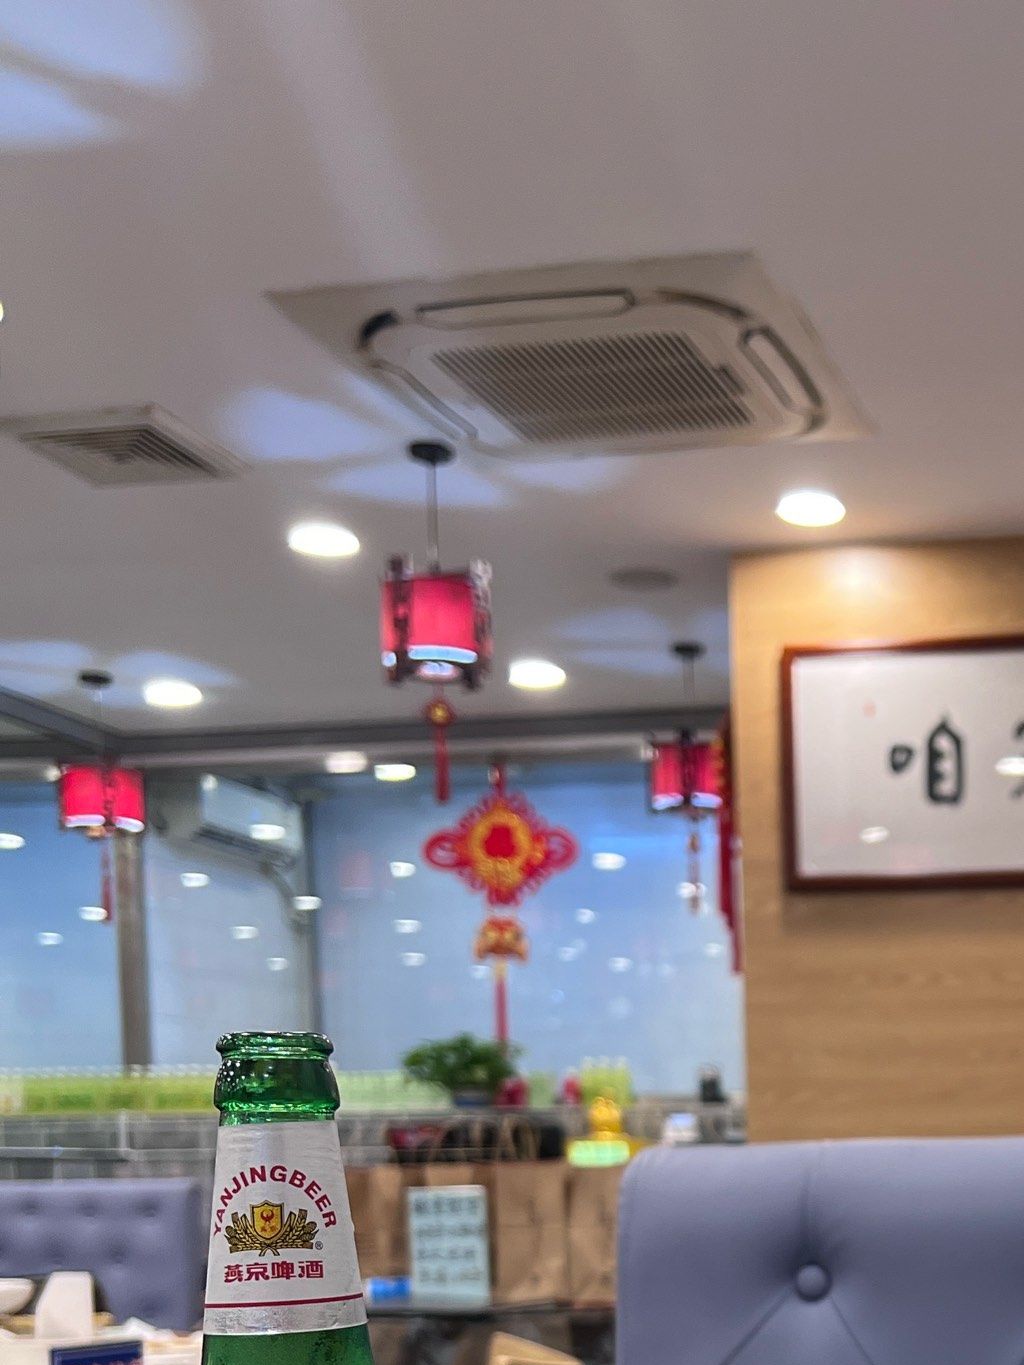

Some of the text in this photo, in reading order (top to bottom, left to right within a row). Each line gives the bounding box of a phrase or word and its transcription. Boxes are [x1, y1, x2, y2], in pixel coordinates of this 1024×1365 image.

[213, 1164, 337, 1236] YANJINGBEER
[223, 1260, 324, 1284] 燕京啤酒
